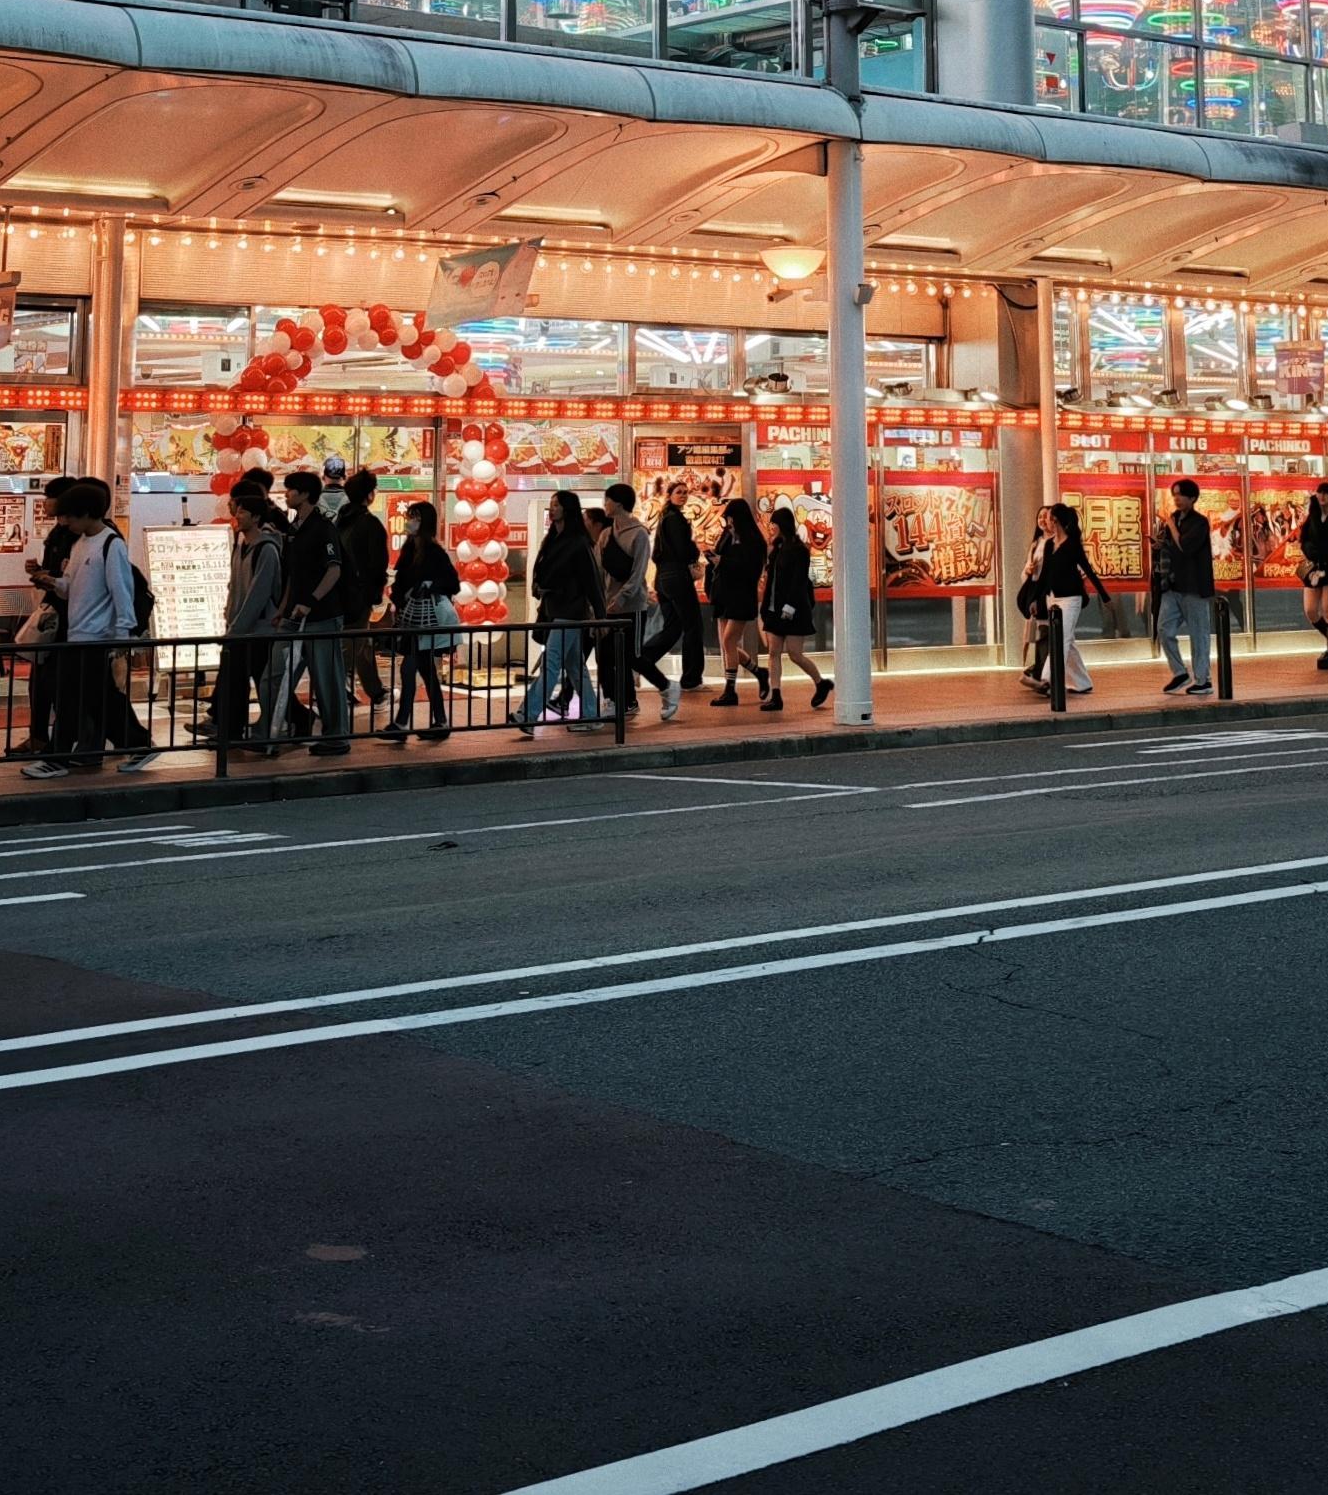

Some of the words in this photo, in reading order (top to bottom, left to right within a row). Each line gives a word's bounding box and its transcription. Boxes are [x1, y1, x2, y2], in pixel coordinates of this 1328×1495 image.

[767, 425, 832, 442] PACHIN
[1070, 434, 1112, 449] SLOT
[1169, 436, 1208, 451] KING
[1250, 438, 1311, 453] PACHINKO
[149, 541, 229, 554] スロットランキング
